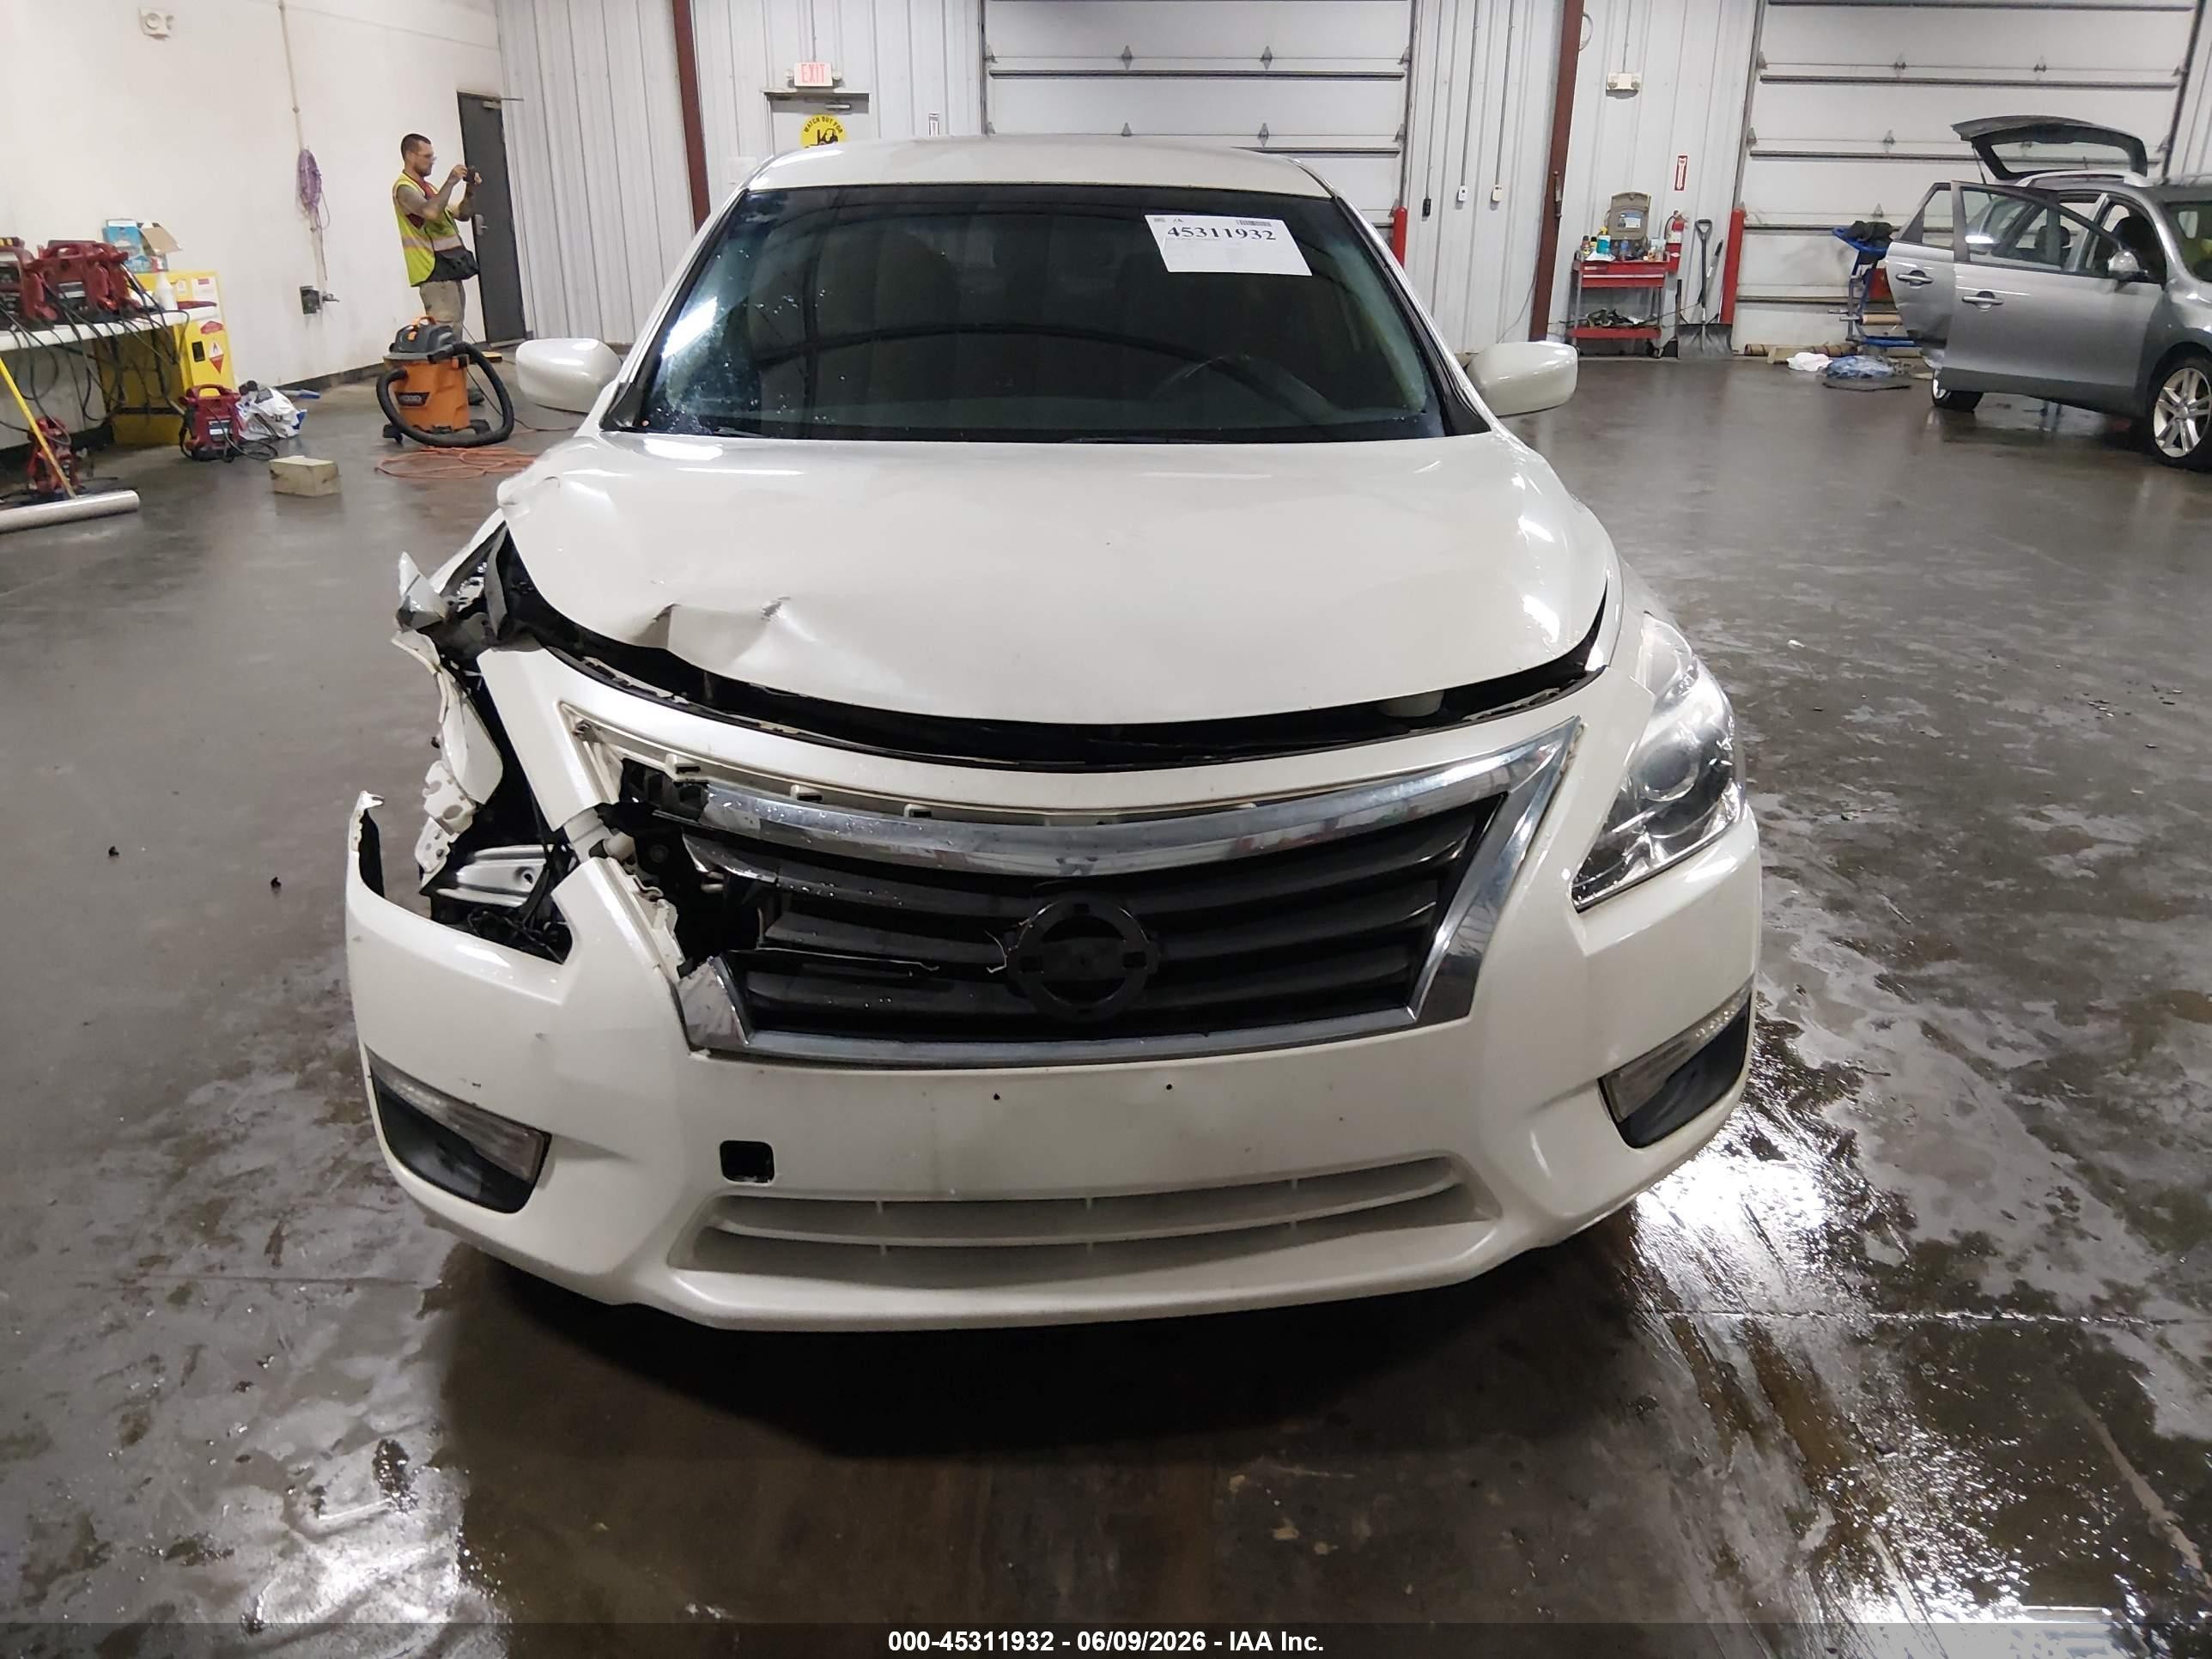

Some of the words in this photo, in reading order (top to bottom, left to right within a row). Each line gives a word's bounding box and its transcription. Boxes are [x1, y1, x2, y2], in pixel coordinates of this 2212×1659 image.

[800, 64, 825, 83] EXIT
[804, 117, 820, 132] WATCH
[1167, 226, 1276, 240] 45311932
